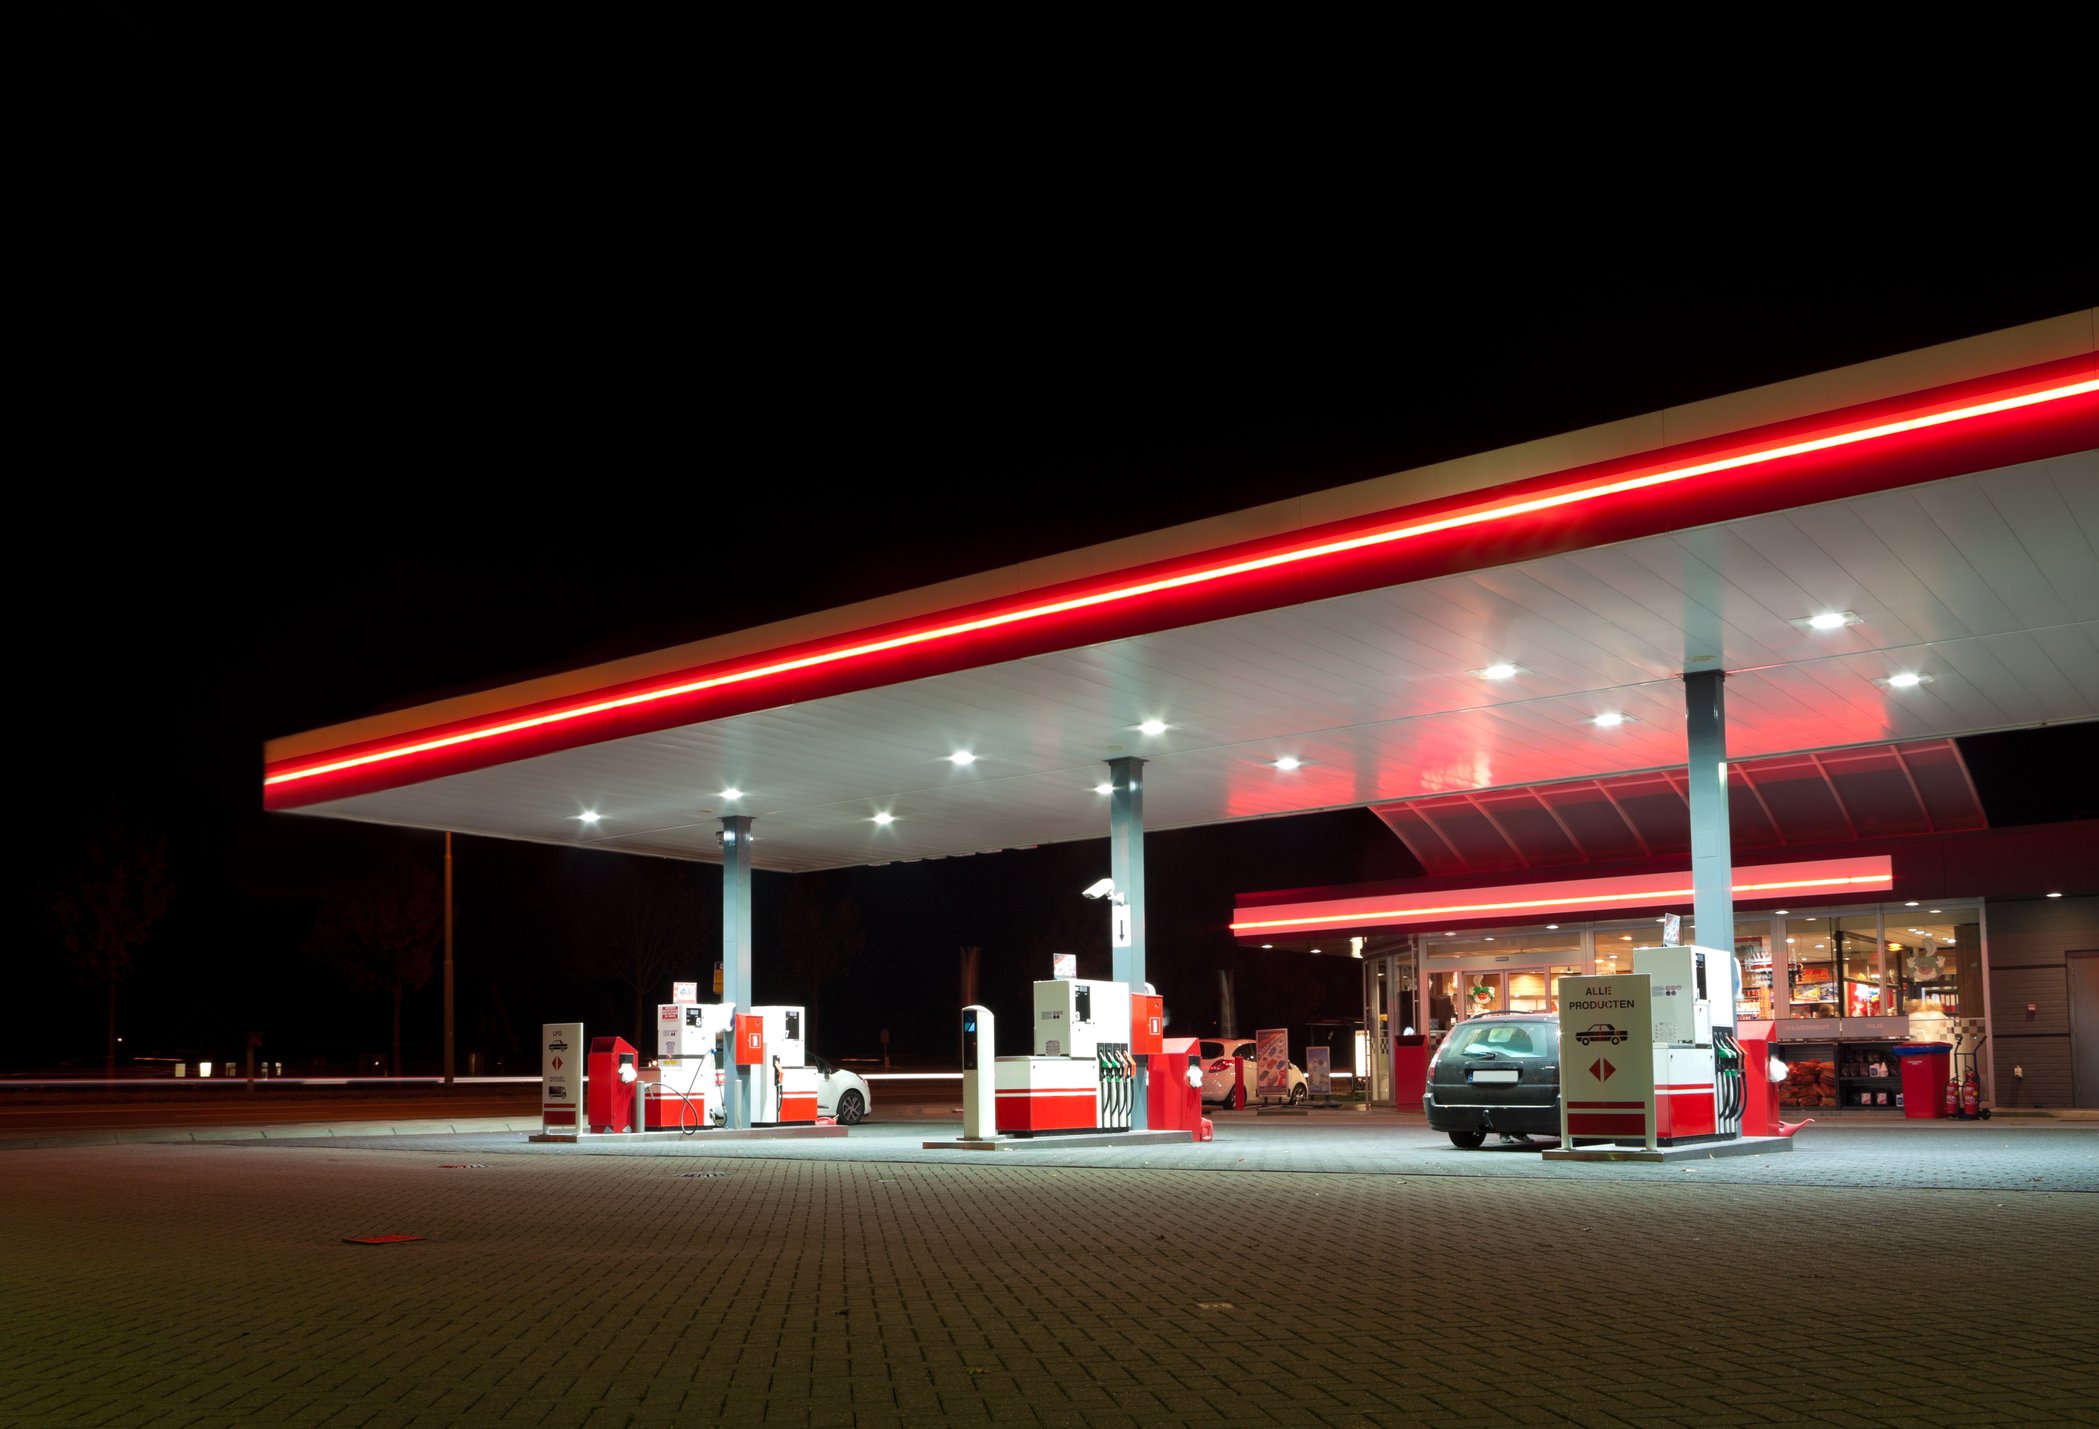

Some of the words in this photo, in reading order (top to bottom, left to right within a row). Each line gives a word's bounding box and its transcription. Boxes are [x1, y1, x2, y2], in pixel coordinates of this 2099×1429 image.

[1585, 986, 1612, 996] ALLE
[1569, 999, 1635, 1010] PRODUCTEN
[696, 1017, 702, 1026] 5
